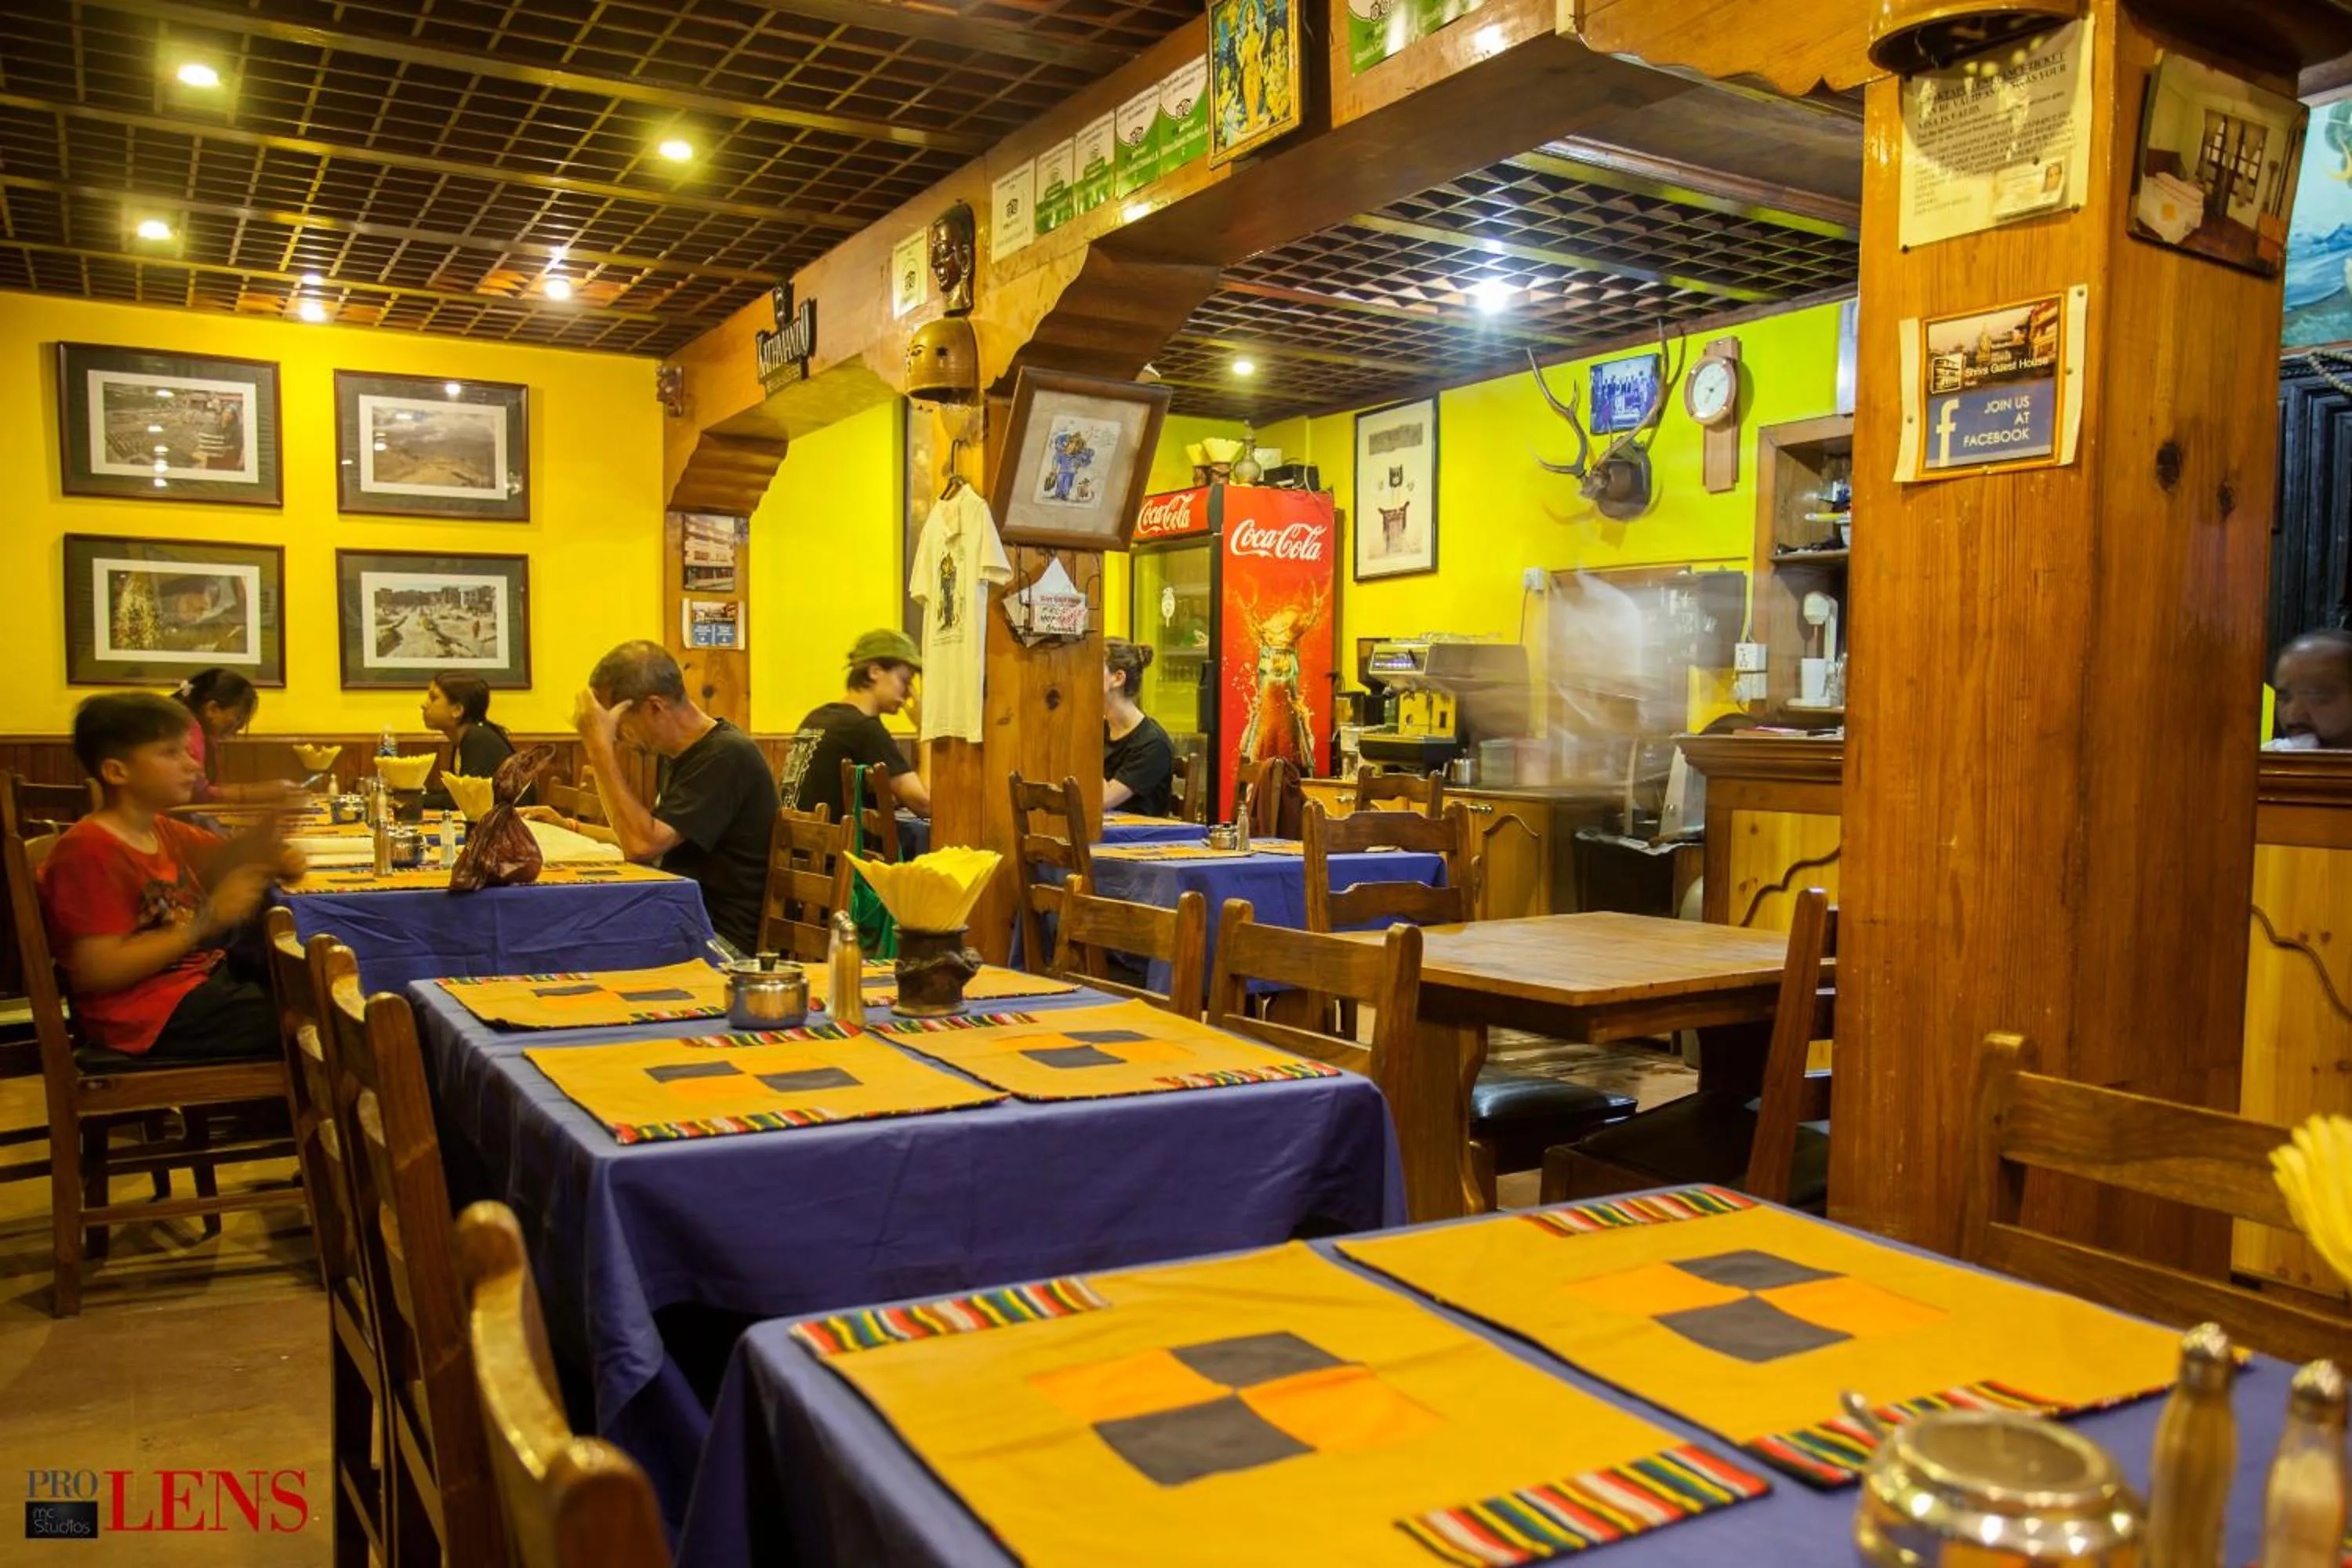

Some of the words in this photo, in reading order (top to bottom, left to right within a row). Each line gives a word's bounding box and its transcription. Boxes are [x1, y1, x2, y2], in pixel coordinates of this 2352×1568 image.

[757, 302, 810, 379] KATHMANDU
[1991, 360, 2017, 374] Guest
[2019, 357, 2049, 369] House
[1984, 398, 2013, 414] JOIN
[2015, 395, 2031, 409] US
[2014, 412, 2031, 426] AT
[1963, 429, 2031, 448] FACEBOOK
[1230, 518, 1328, 561] Coca-Cola
